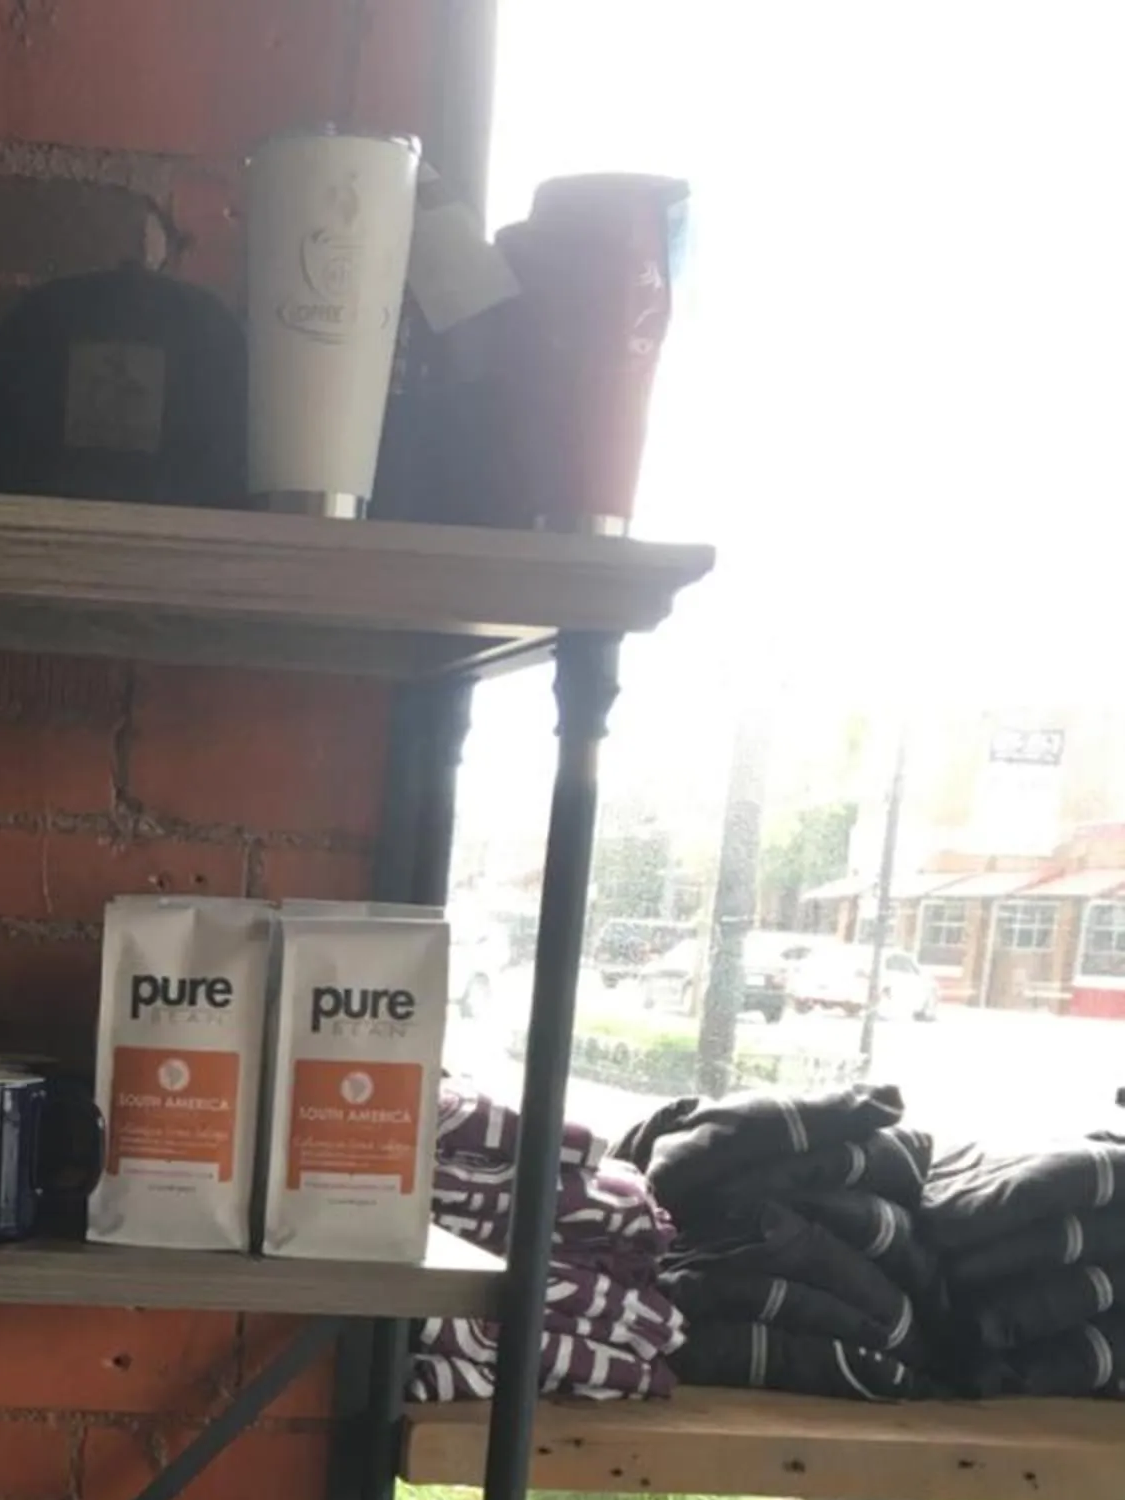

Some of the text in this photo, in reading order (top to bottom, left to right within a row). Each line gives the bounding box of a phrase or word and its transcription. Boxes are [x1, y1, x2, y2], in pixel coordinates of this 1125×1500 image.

[129, 974, 234, 1020] pure
[310, 986, 417, 1033] pure
[346, 1107, 413, 1123] AMERICA
